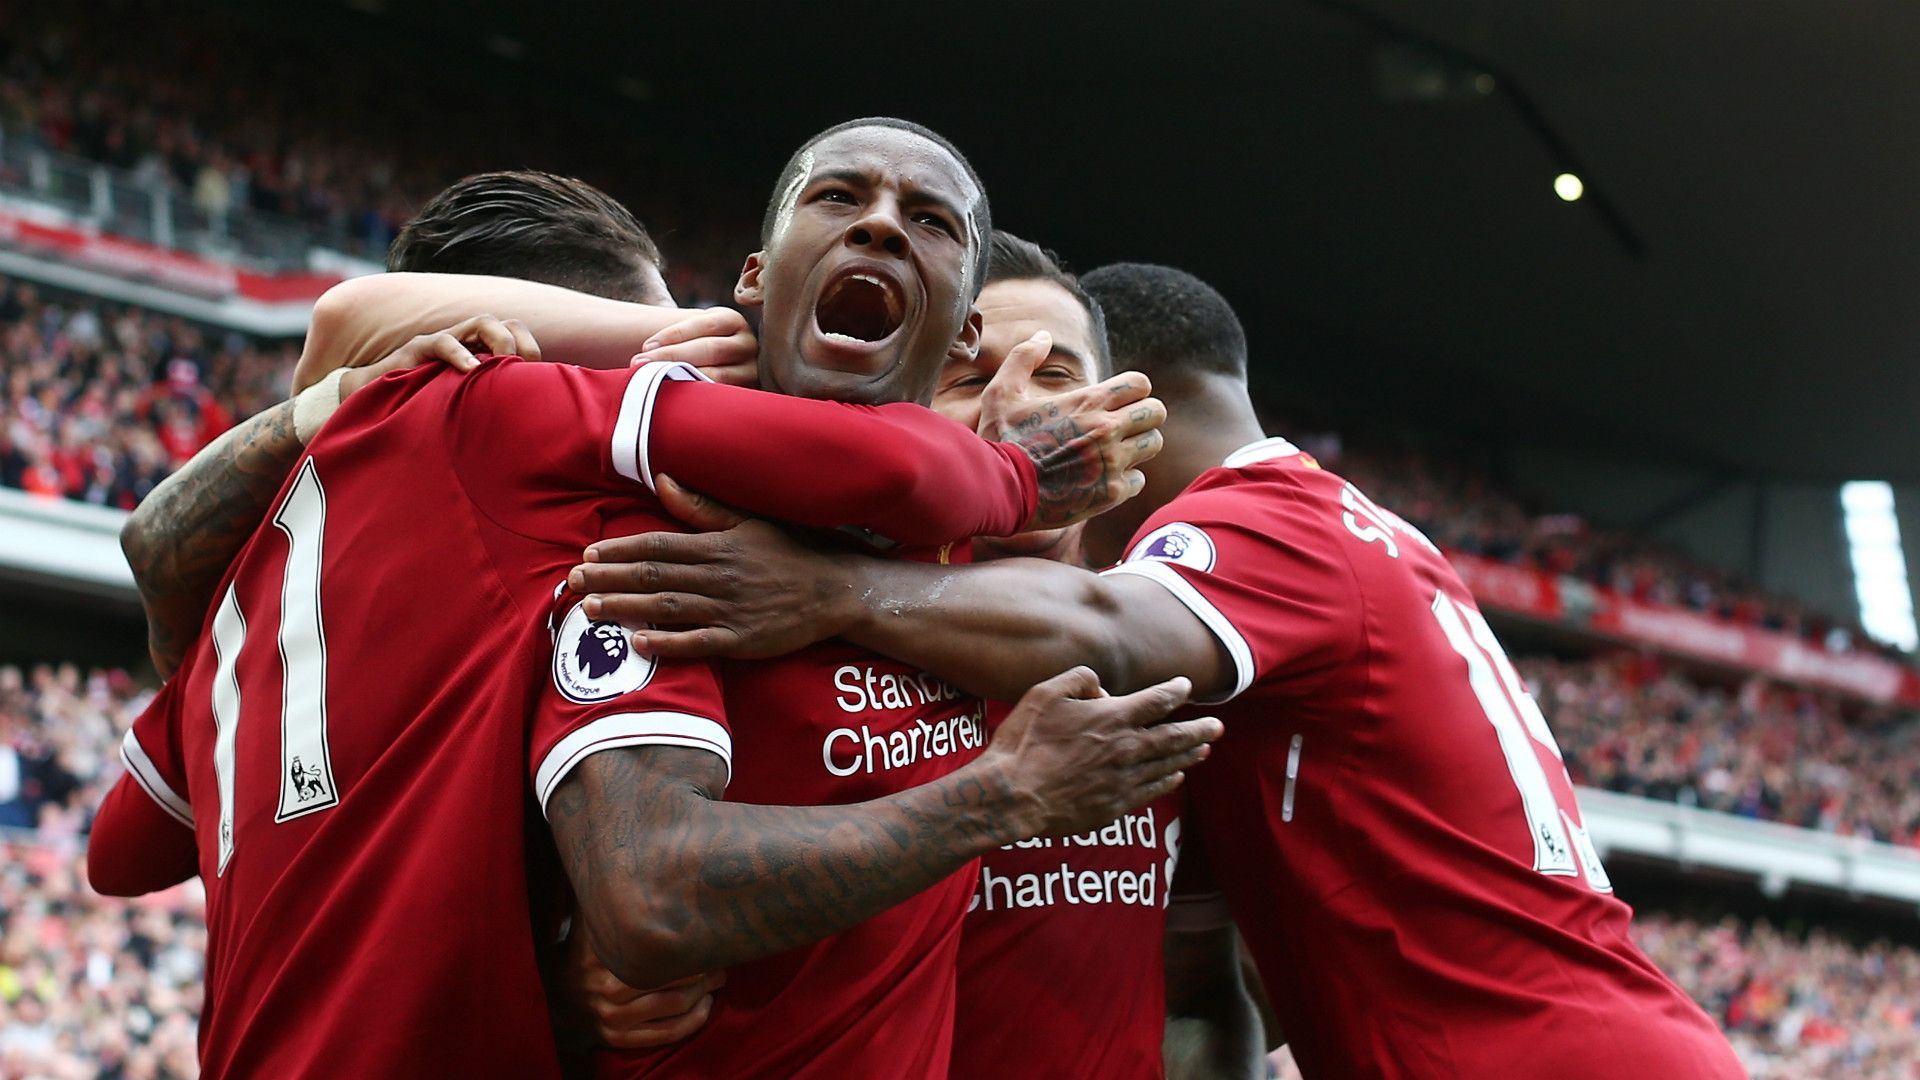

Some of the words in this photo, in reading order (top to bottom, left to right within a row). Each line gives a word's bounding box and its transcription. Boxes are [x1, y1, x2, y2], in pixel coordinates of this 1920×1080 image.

[211, 455, 340, 878] 11
[561, 652, 573, 686] Premier
[571, 682, 601, 696] League
[822, 701, 983, 777] Chartered
[967, 863, 1156, 913] hartered
